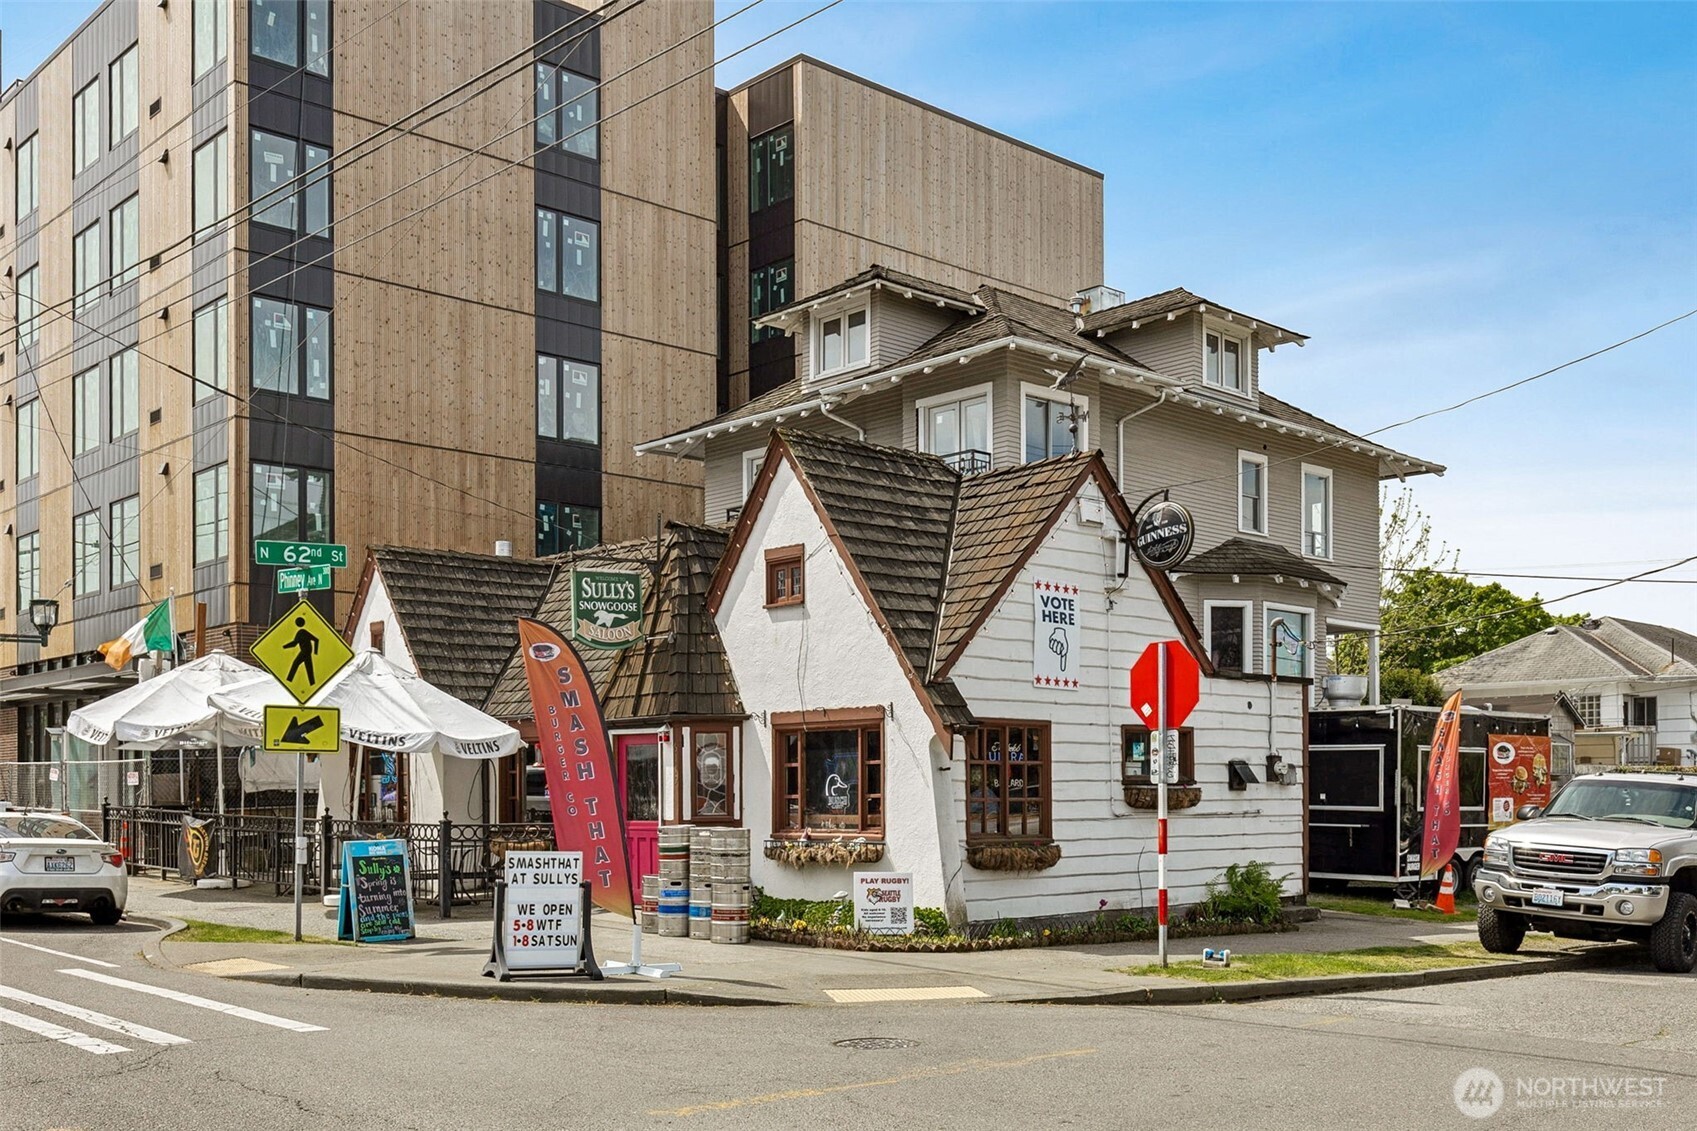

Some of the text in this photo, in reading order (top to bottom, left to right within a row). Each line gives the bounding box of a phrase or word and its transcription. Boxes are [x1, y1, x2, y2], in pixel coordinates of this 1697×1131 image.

[1138, 523, 1187, 547] GUINNESS
[260, 546, 343, 563] N 62nd St
[280, 571, 323, 590] Phinney Ave N
[582, 577, 635, 599] SULLY'S
[579, 601, 638, 612] SNOWGOOSE
[1040, 595, 1075, 611] VOTE
[1042, 609, 1075, 626] HERE
[589, 625, 633, 640] SALOON
[350, 728, 406, 747] VELTINS
[461, 739, 501, 755] VELTINS
[548, 705, 578, 817] BURGER CO
[556, 666, 611, 888] SMASH THAT
[1430, 727, 1446, 860] SMASH THAT
[508, 857, 580, 870] SMASHTHAT
[1539, 851, 1575, 864] GMC
[359, 860, 392, 880] Sully's
[361, 876, 396, 891] Spring is
[511, 873, 579, 885] AT SULLYS
[358, 888, 407, 906] turning into
[360, 914, 375, 924] and
[376, 911, 391, 921] the
[517, 904, 573, 916] WE OPEN
[360, 922, 374, 930] are
